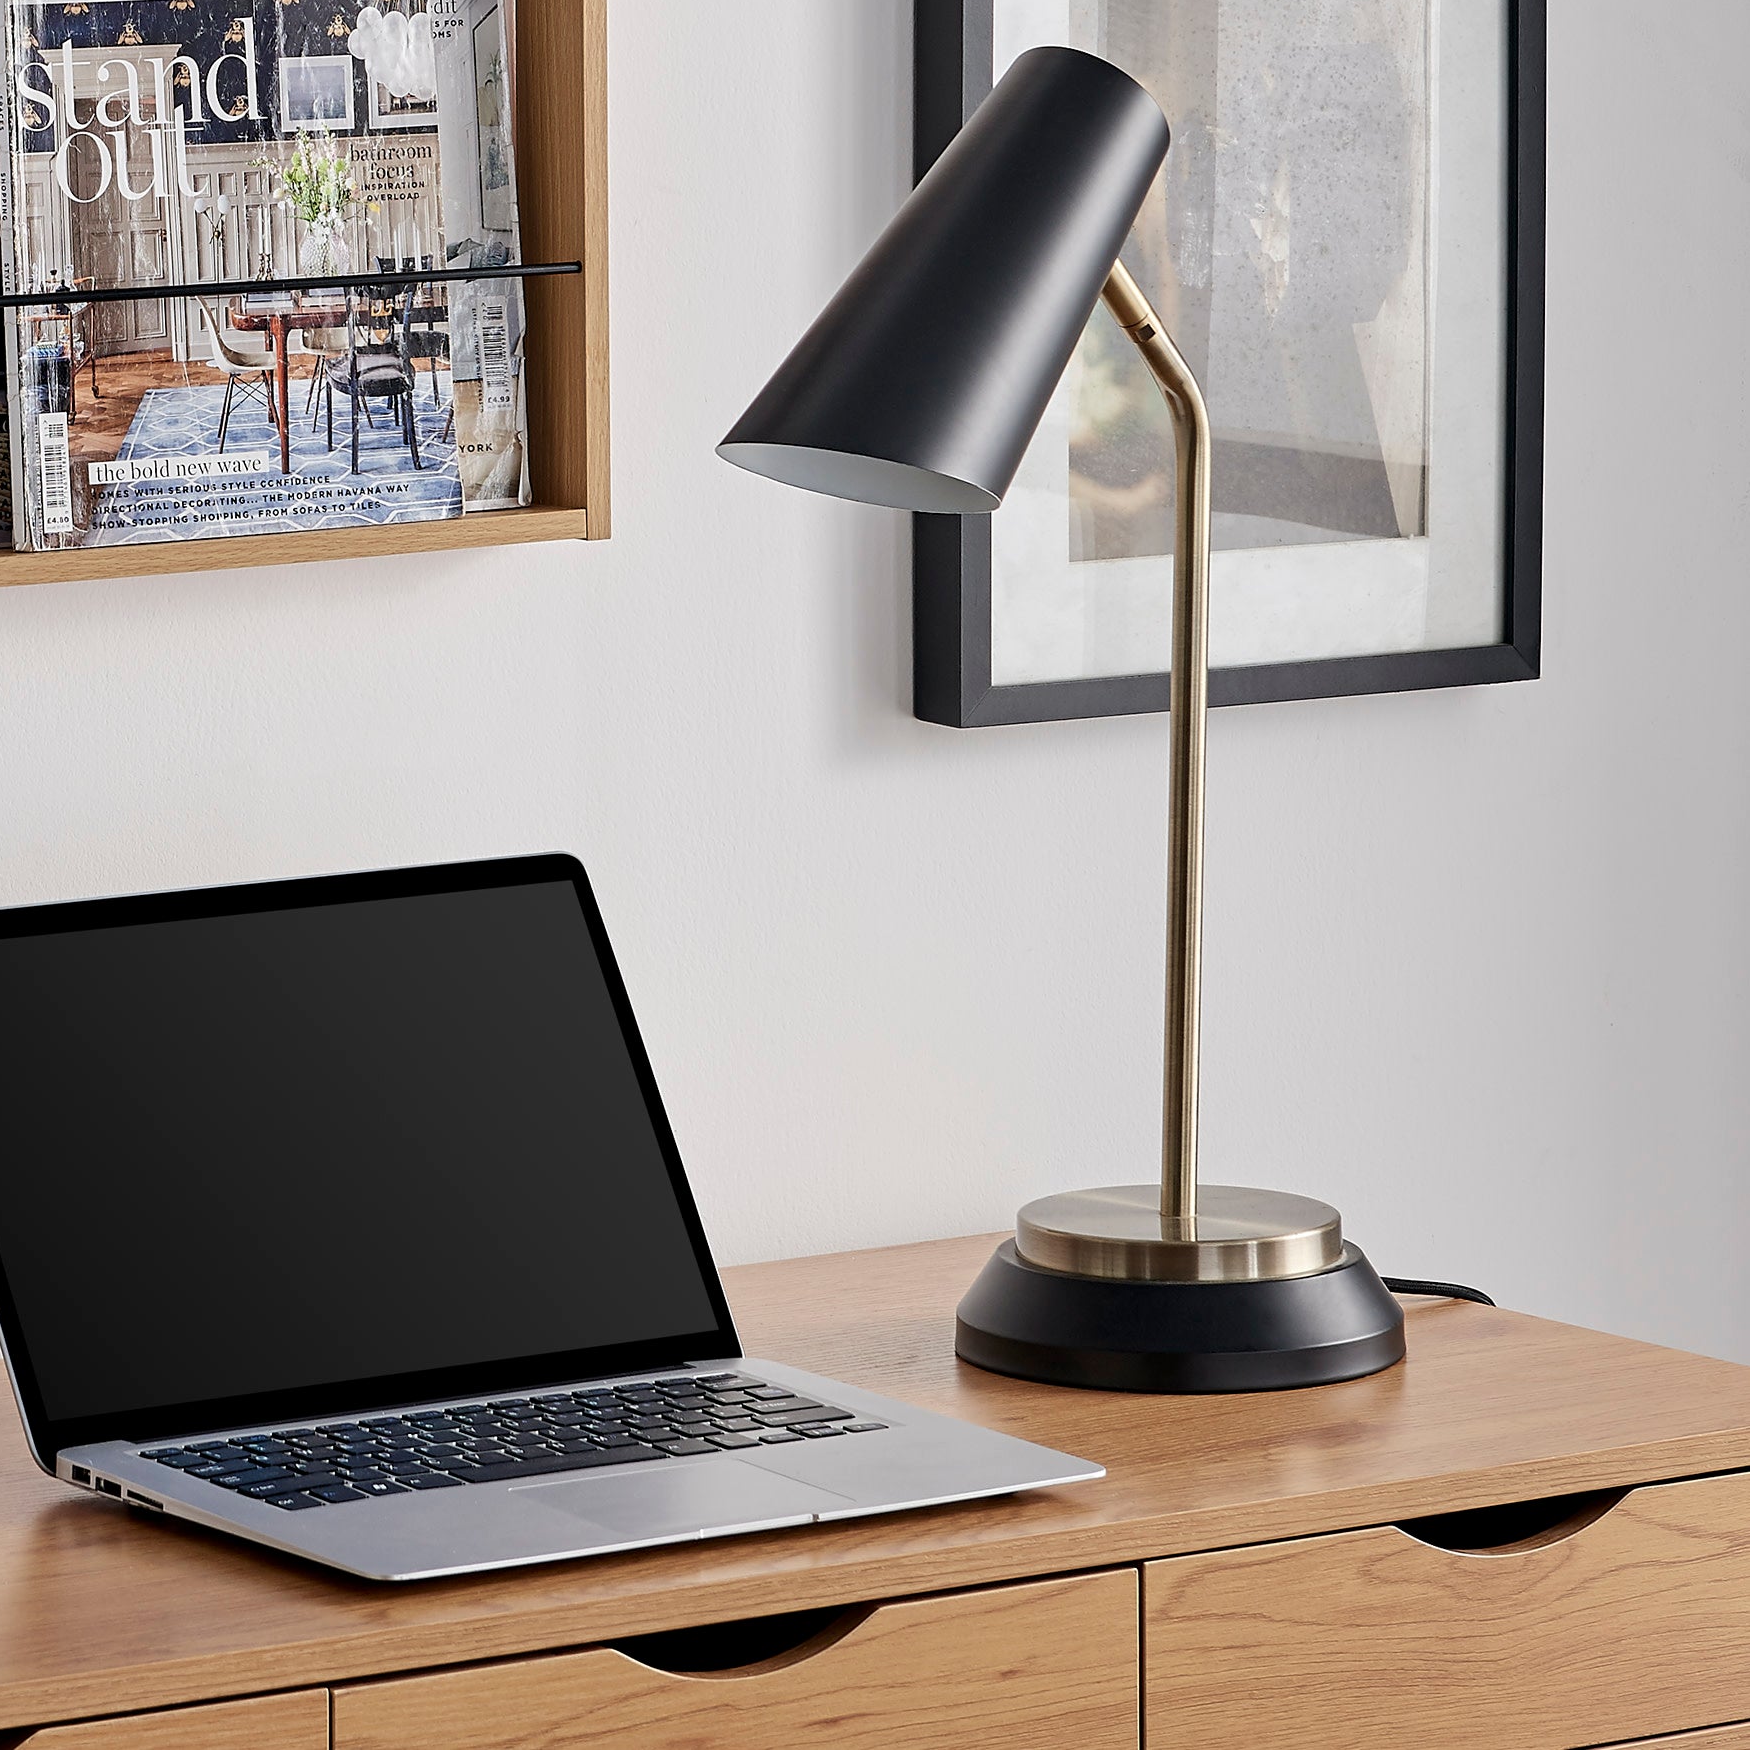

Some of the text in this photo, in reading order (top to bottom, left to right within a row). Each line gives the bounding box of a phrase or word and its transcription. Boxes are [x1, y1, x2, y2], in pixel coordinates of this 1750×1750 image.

[444, 19, 464, 28] FOR
[17, 17, 270, 134] stand
[55, 103, 210, 204] out
[350, 144, 432, 162] bathroom
[370, 161, 415, 180] focus
[361, 180, 425, 192] INSPIRATION
[366, 192, 420, 202] OVERLOAD
[459, 442, 493, 454] YORK
[96, 458, 262, 483] the bold new wave
[134, 487, 164, 498] WITH
[168, 483, 217, 496] SERIOUS
[220, 480, 256, 491] STYLE
[260, 475, 331, 489] CONFIDENCE
[91, 502, 170, 516] DIRECTIONAL
[262, 493, 284, 503] THE
[287, 488, 333, 501] MODERN
[337, 485, 382, 497] HAVANA
[386, 483, 410, 493] WAY
[92, 500, 381, 531] SHOW-STOPPING SHOPPING, FROM SOFAS TO TILES
